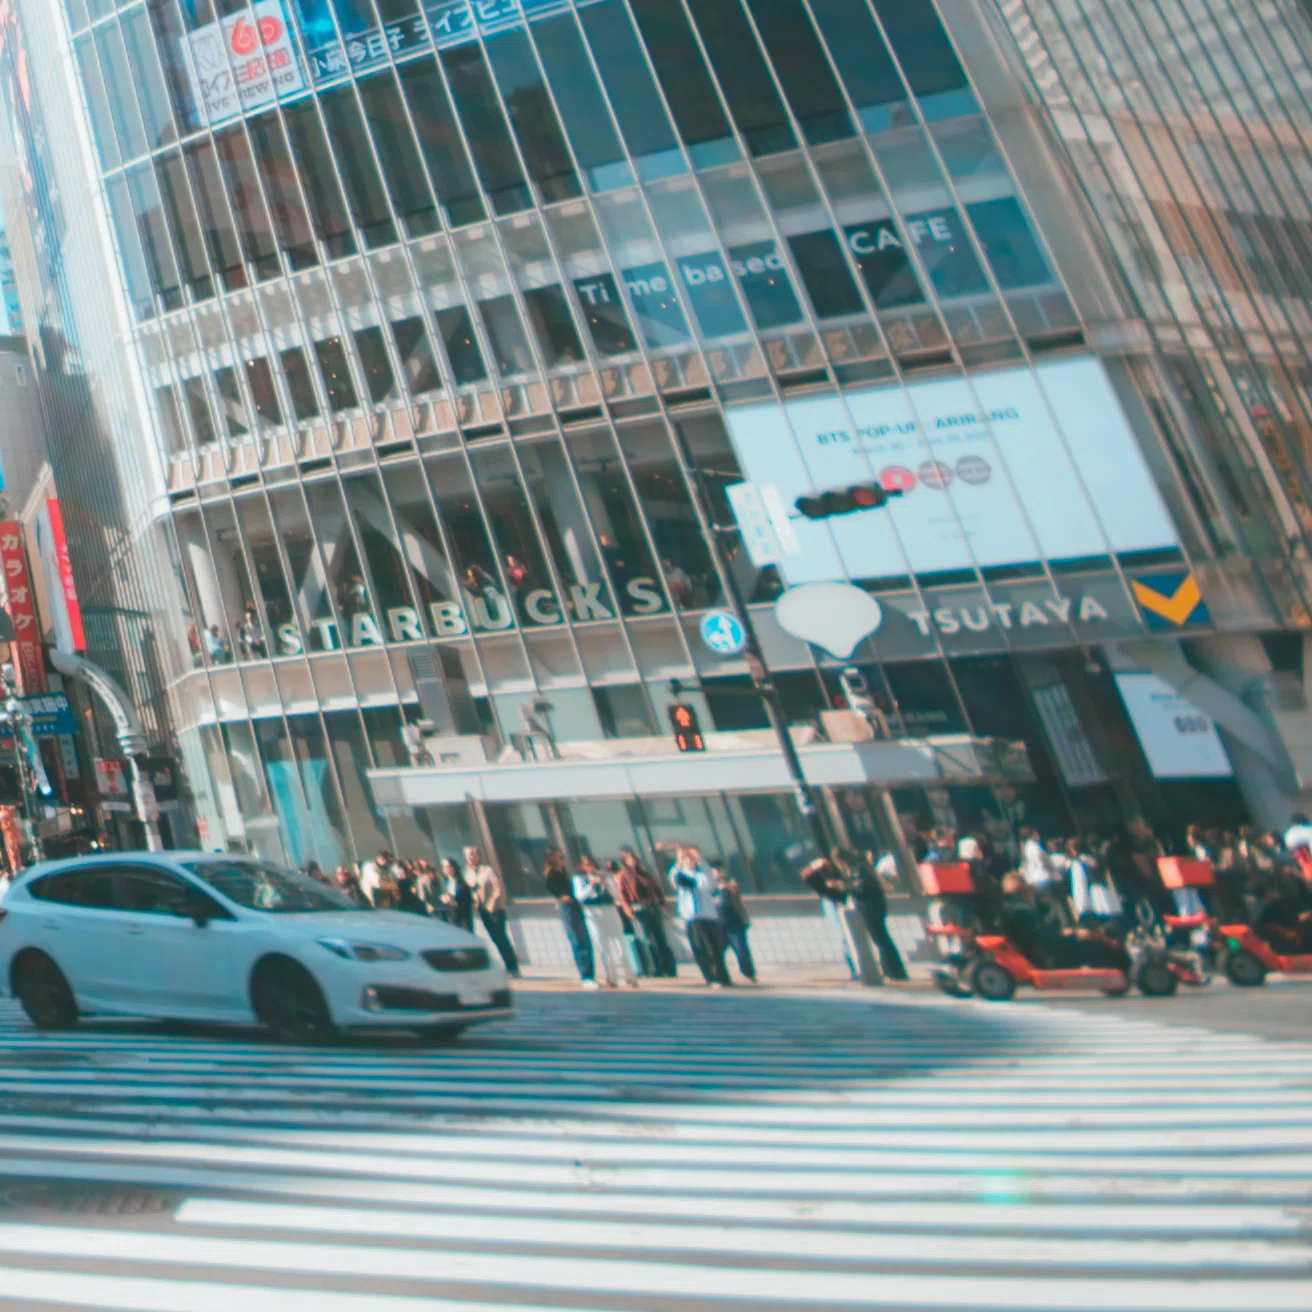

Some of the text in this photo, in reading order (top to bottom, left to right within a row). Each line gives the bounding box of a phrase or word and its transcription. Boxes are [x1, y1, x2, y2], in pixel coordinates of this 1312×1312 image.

[578, 216, 952, 306] Time based CAFE
[817, 431, 850, 444] BTS
[2, 534, 34, 630] カラオケ
[277, 577, 662, 655] STARBUCKS
[908, 596, 1108, 637] TSUTAYA
